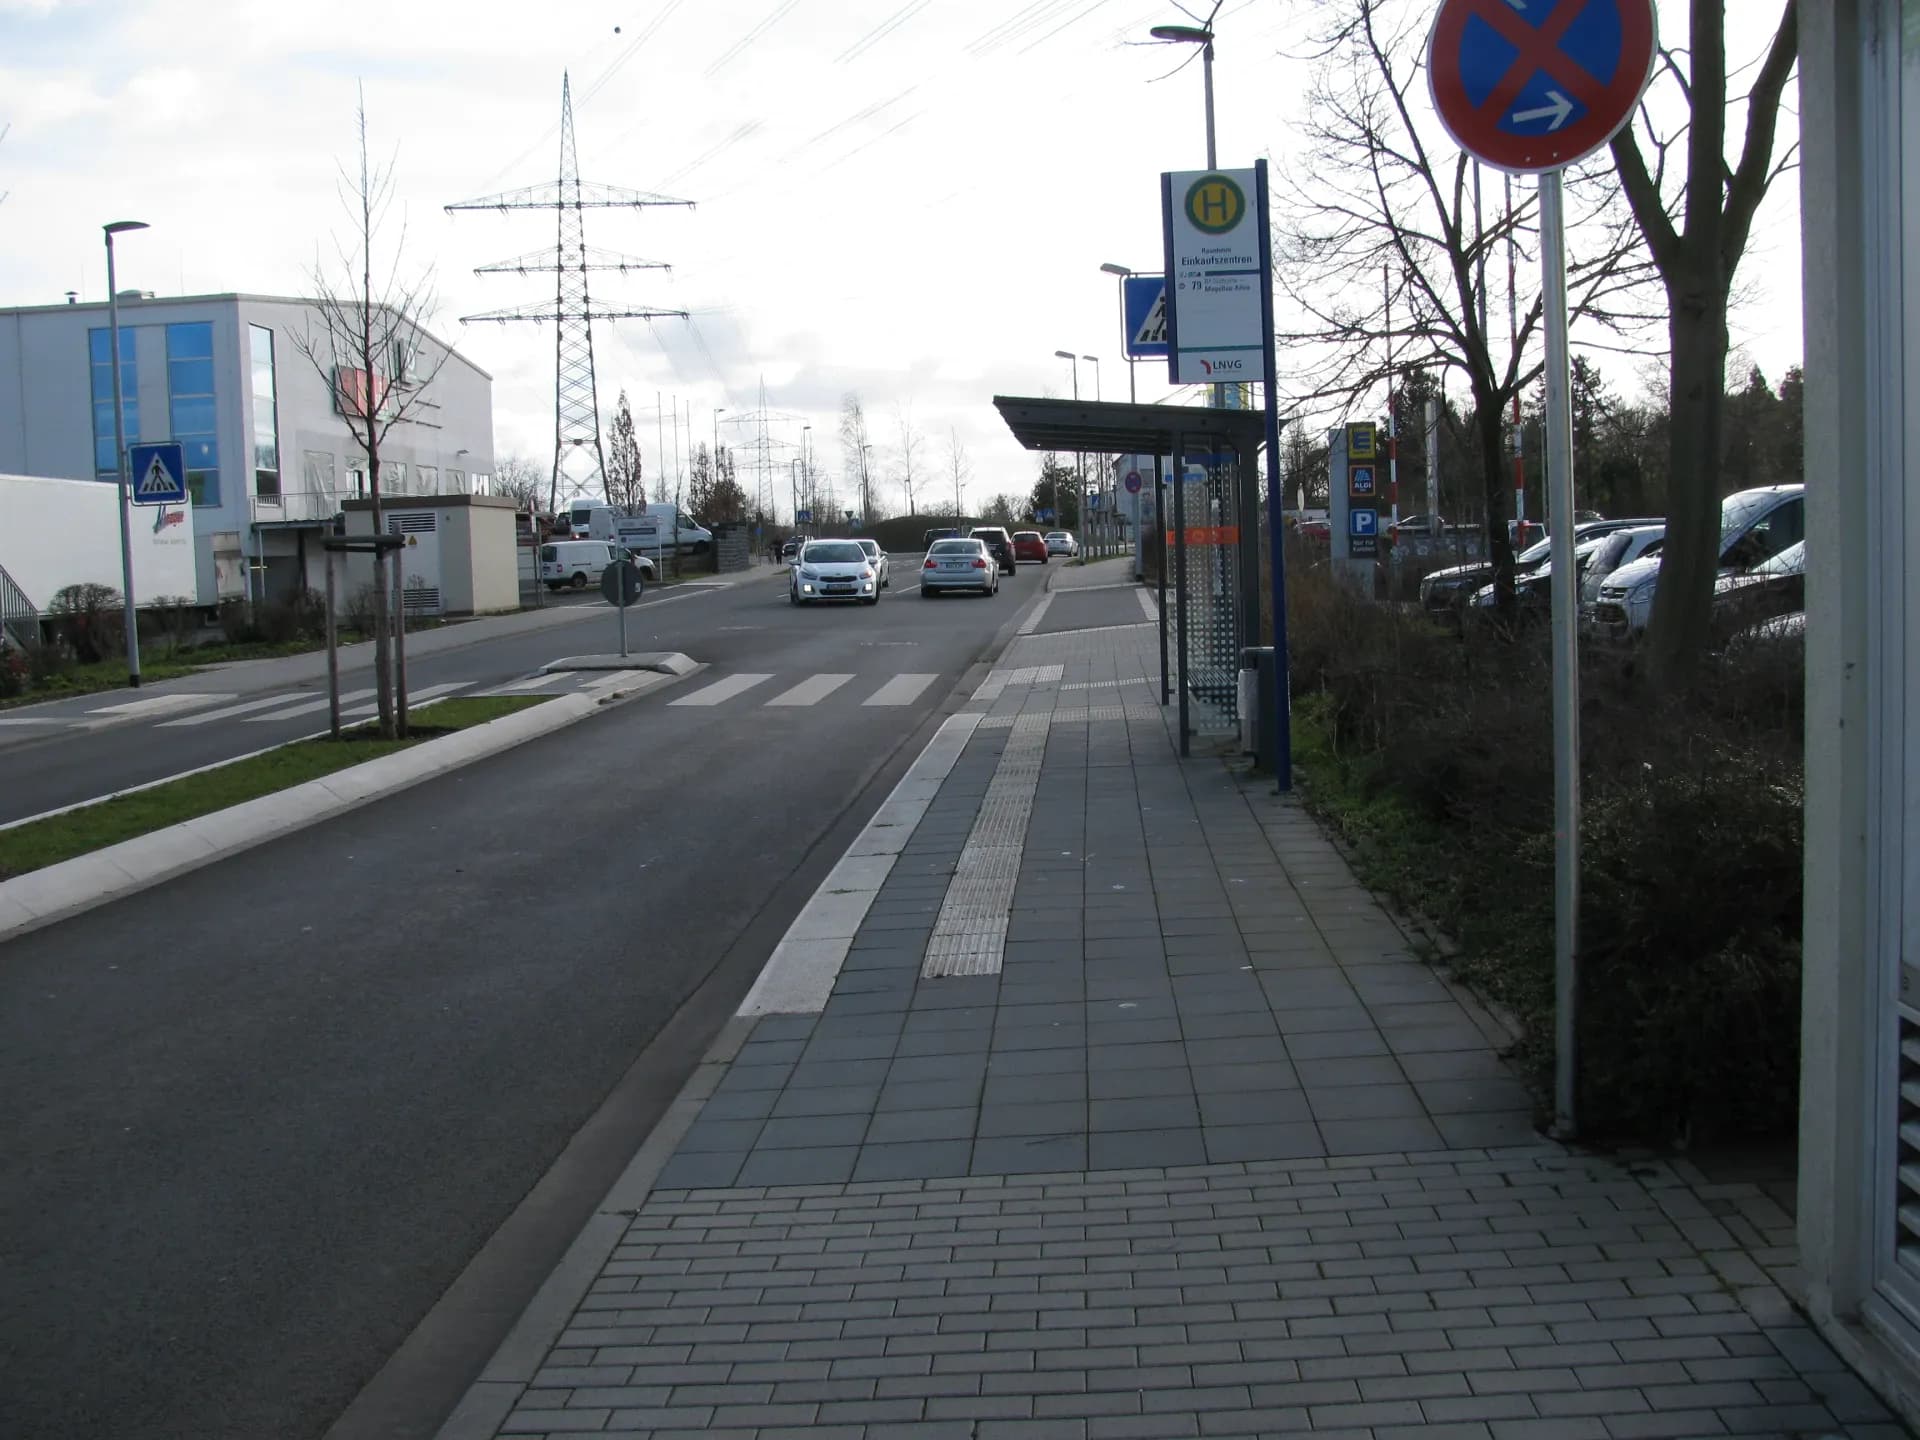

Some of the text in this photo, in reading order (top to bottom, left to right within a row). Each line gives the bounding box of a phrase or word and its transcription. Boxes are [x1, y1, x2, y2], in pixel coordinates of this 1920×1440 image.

[1202, 187, 1227, 222] H
[1181, 255, 1252, 266] Einkaufszentren
[1192, 280, 1202, 290] 79
[1213, 359, 1242, 370] LNVG
[1356, 513, 1372, 533] P
